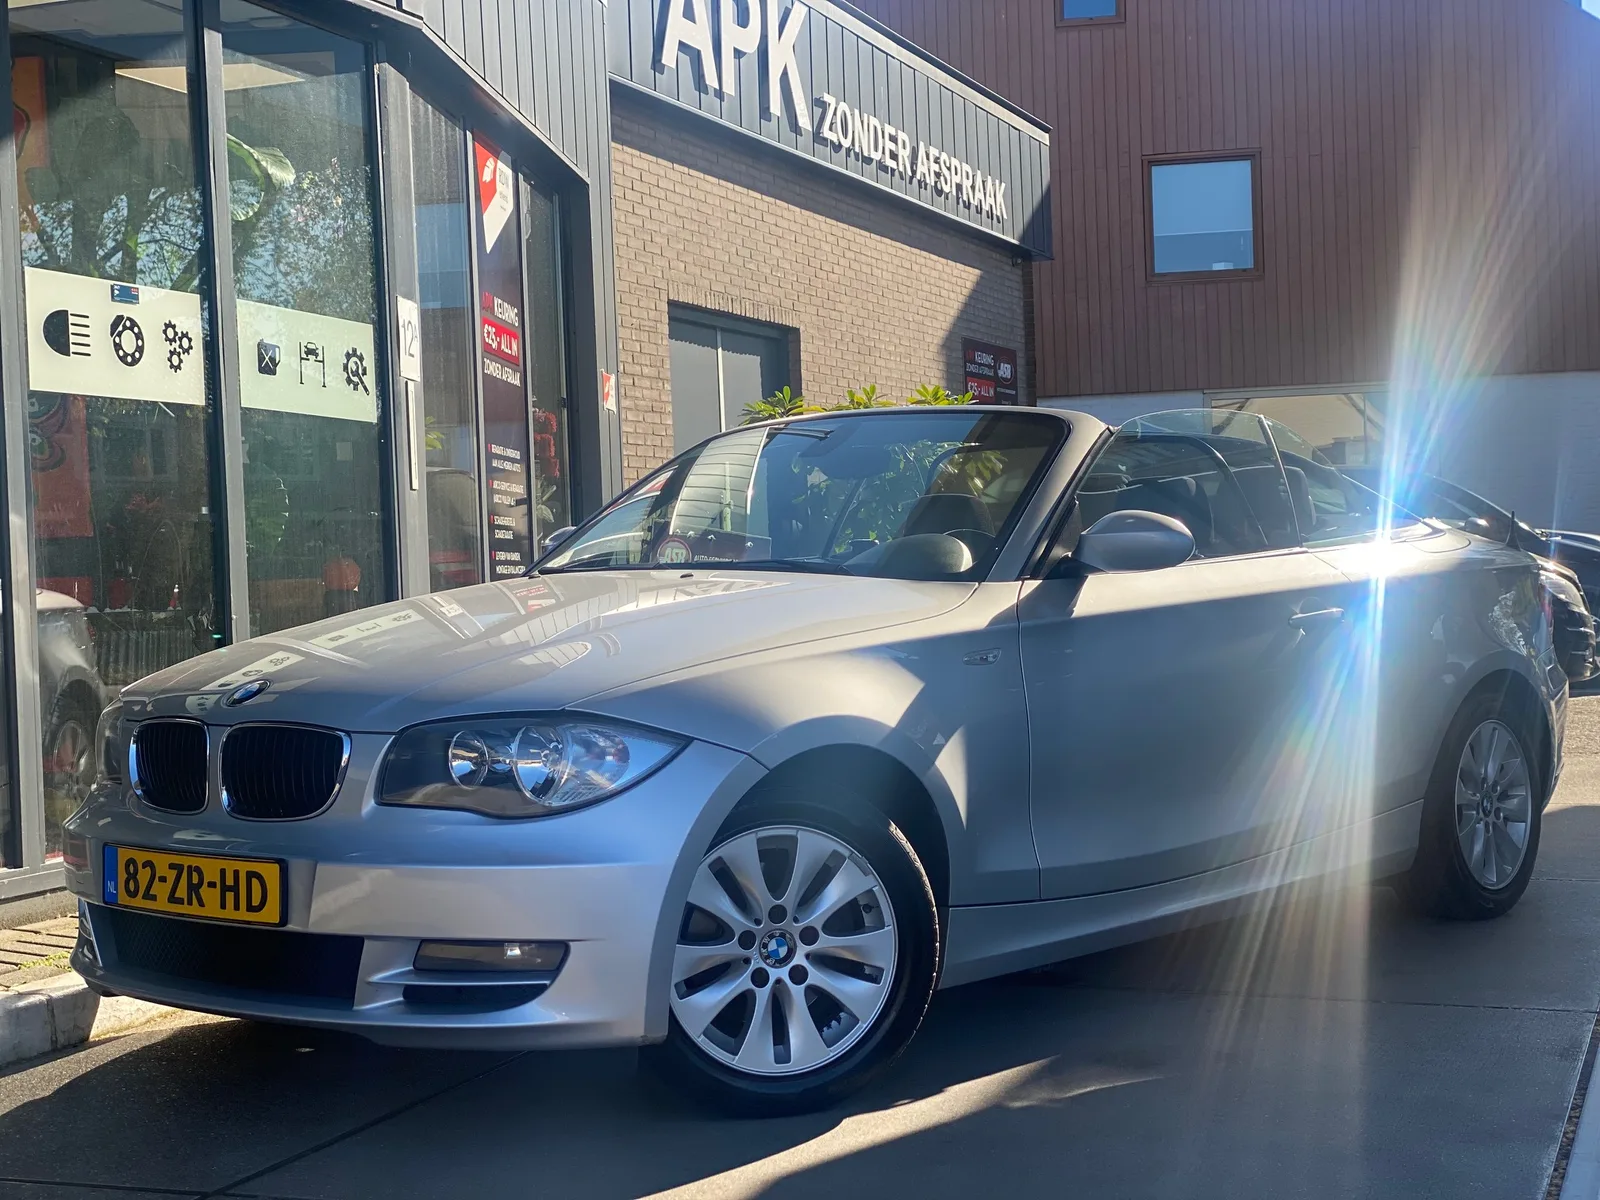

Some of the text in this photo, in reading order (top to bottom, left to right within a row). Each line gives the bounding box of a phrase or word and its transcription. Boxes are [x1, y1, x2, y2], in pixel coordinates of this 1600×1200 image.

[661, 0, 812, 131] APK
[820, 92, 1008, 219] ZONDER AFSPRAAK
[493, 296, 519, 327] KEURING
[501, 333, 511, 354] ALL
[512, 336, 518, 357] IN
[974, 351, 994, 366] KEURING
[483, 357, 521, 387] ZONDER AFSPRAAK
[107, 857, 268, 913] NL 82-ZR-HD
